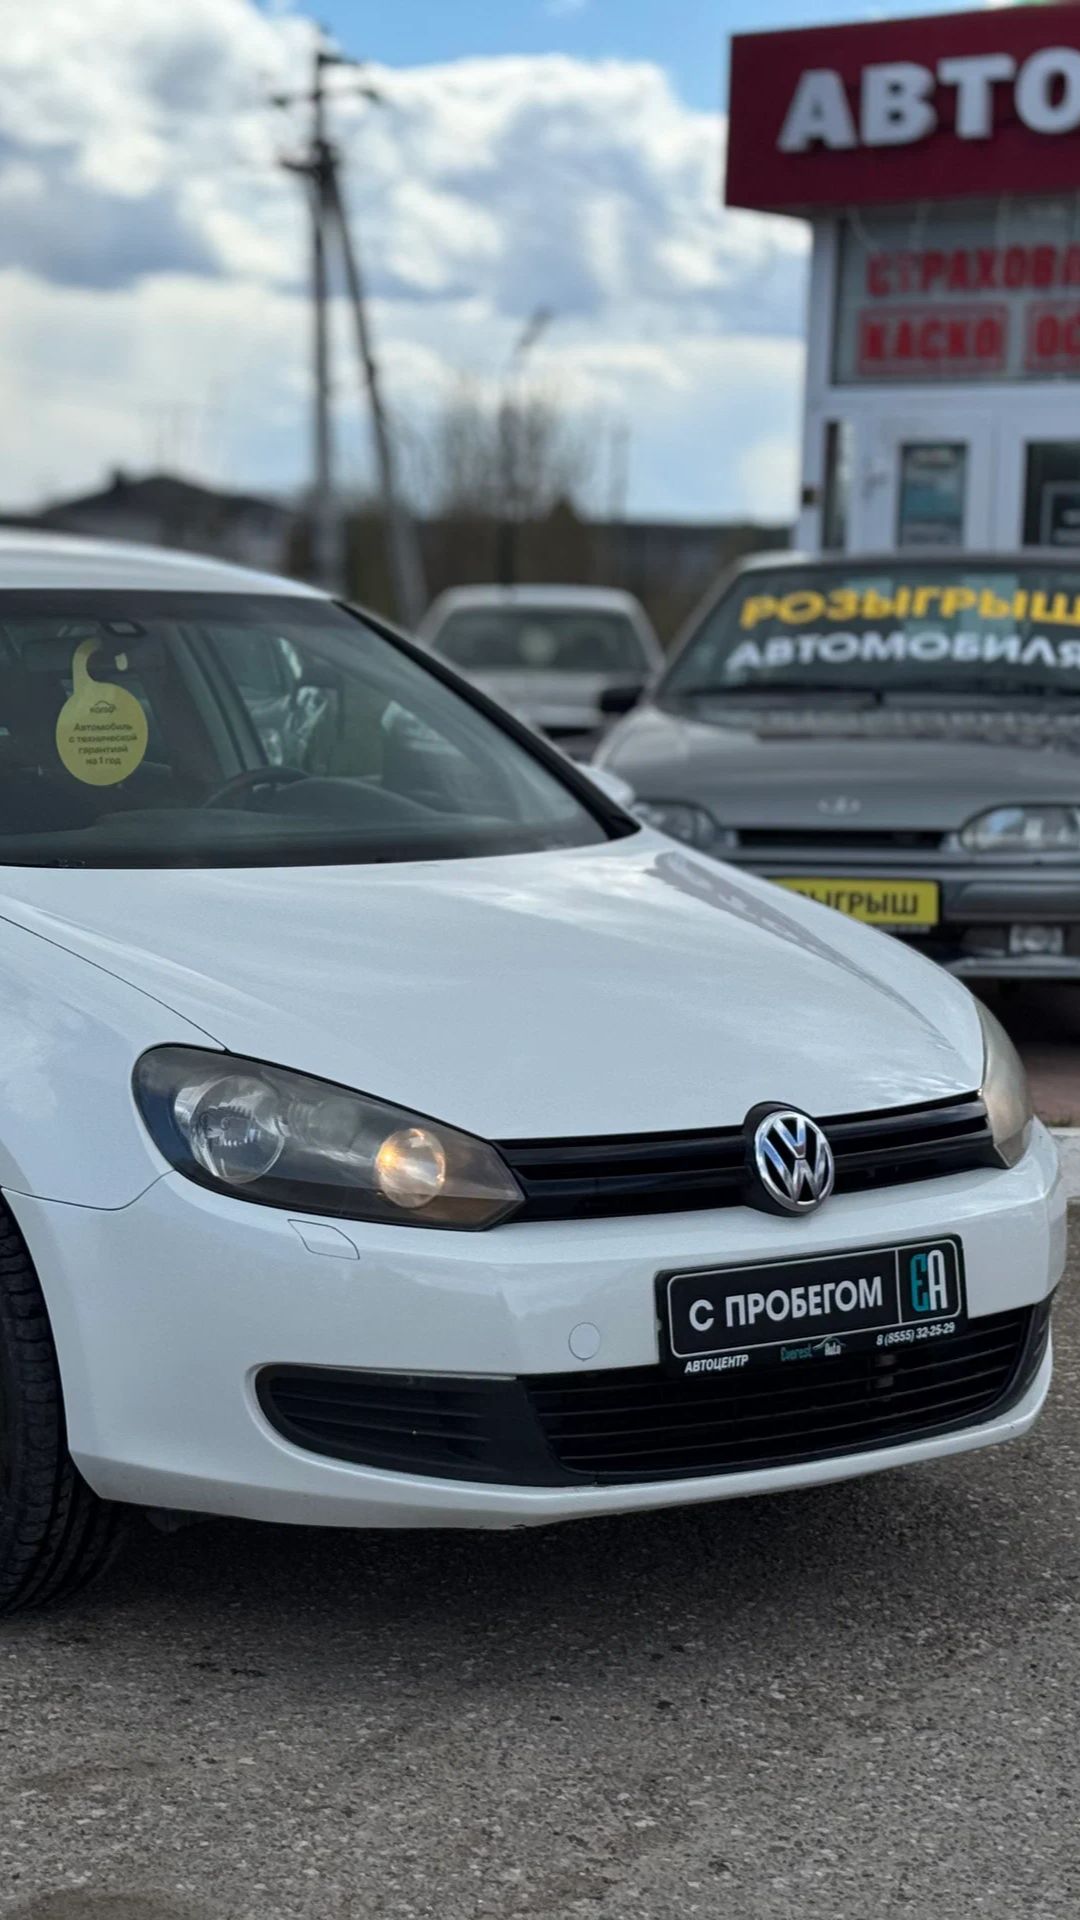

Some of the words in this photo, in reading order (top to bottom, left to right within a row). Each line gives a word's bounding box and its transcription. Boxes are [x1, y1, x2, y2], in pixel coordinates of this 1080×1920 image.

[776, 46, 1080, 153] АВТО
[865, 315, 1000, 361] КАСКО
[740, 586, 1080, 629] РОЗЫГРЫШ
[725, 631, 1080, 671] АВТОМОБИЛЯ
[74, 722, 133, 732] Автомобиль
[77, 733, 138, 743] технической
[105, 757, 122, 766] год
[689, 1299, 714, 1332] С
[725, 1276, 883, 1328] ПРОБЕГОМ
[876, 1334, 883, 1346] 8
[884, 1328, 915, 1347] (8555)
[915, 1321, 956, 1339] 32-25-29
[684, 1354, 749, 1374] АВТОЦЕНТР
